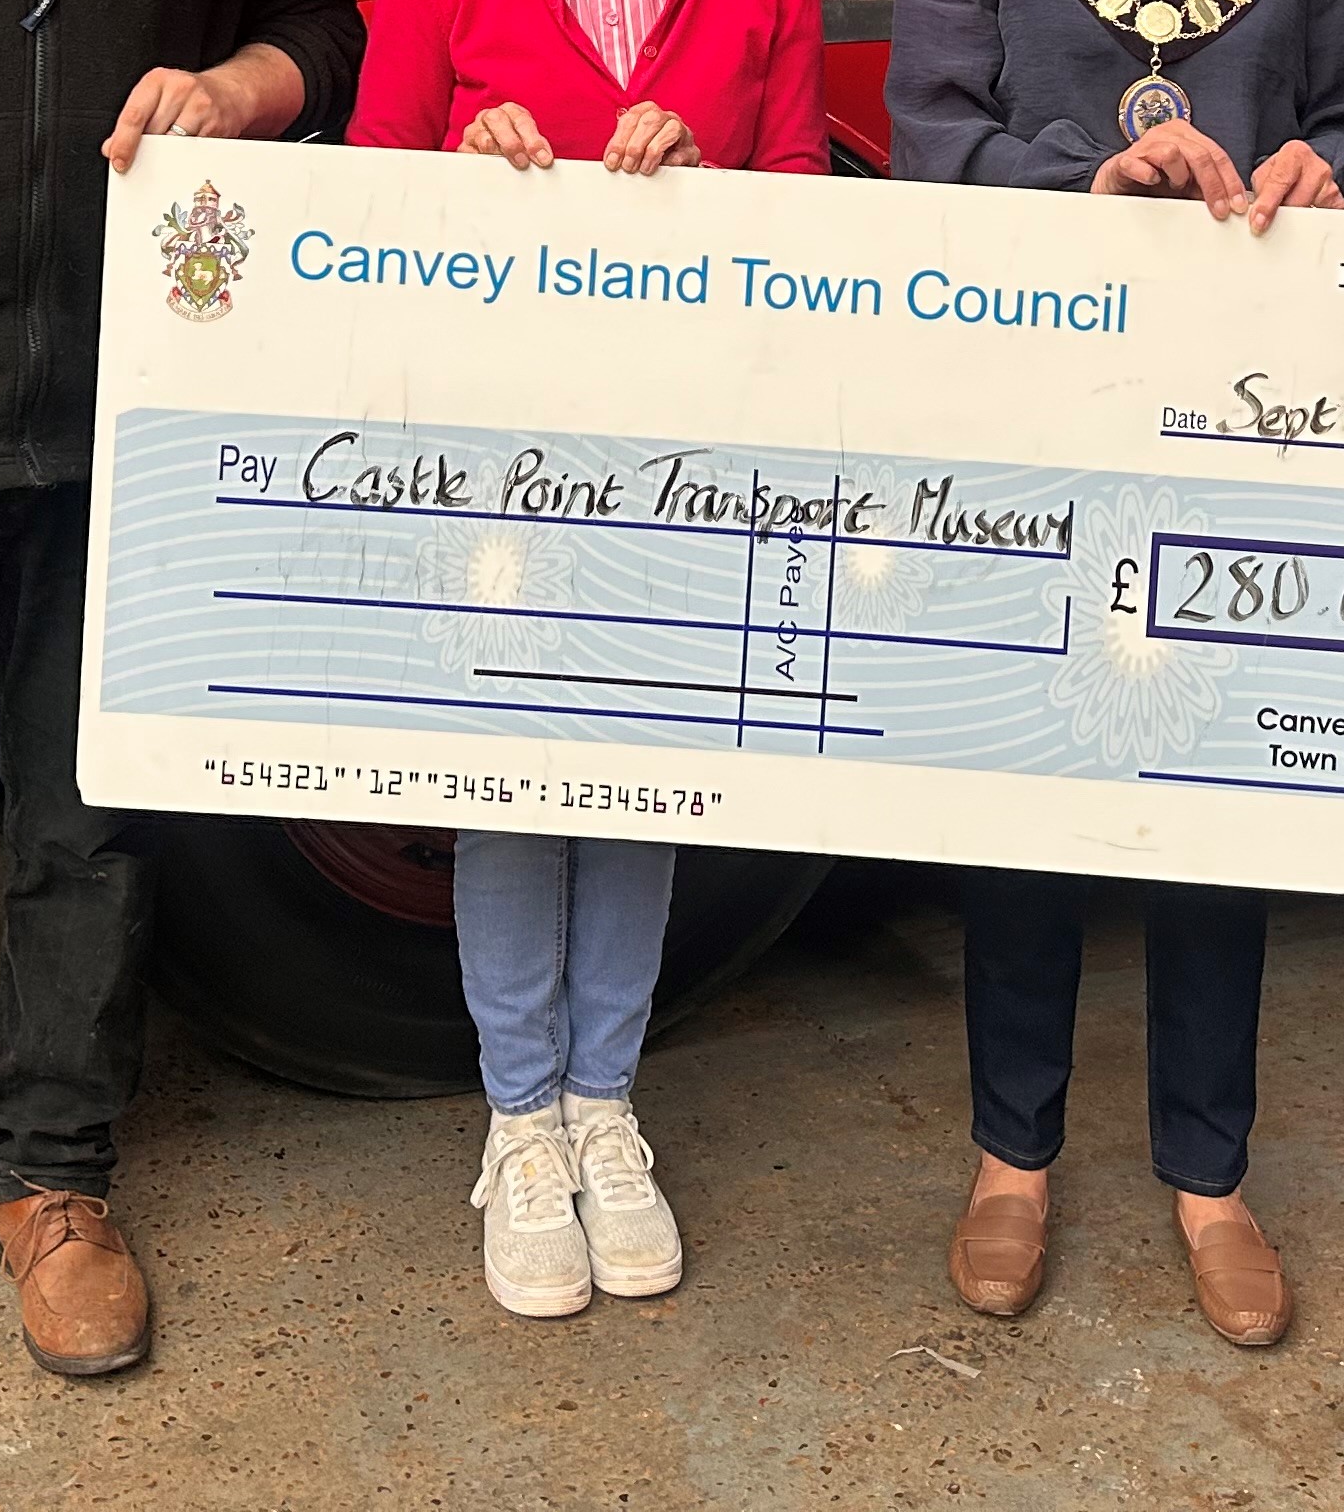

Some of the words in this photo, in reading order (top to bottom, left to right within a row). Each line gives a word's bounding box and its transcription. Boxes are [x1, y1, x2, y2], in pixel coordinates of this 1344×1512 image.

[289, 229, 516, 305] Canvey
[538, 244, 710, 304] Island
[731, 256, 882, 316] Town
[906, 269, 1128, 334] Council
[1162, 406, 1208, 432] Date
[1216, 372, 1339, 458] Sept
[217, 443, 277, 493] Pay
[301, 431, 474, 511] Castle
[1110, 557, 1140, 615] £
[1268, 743, 1337, 772] Town
